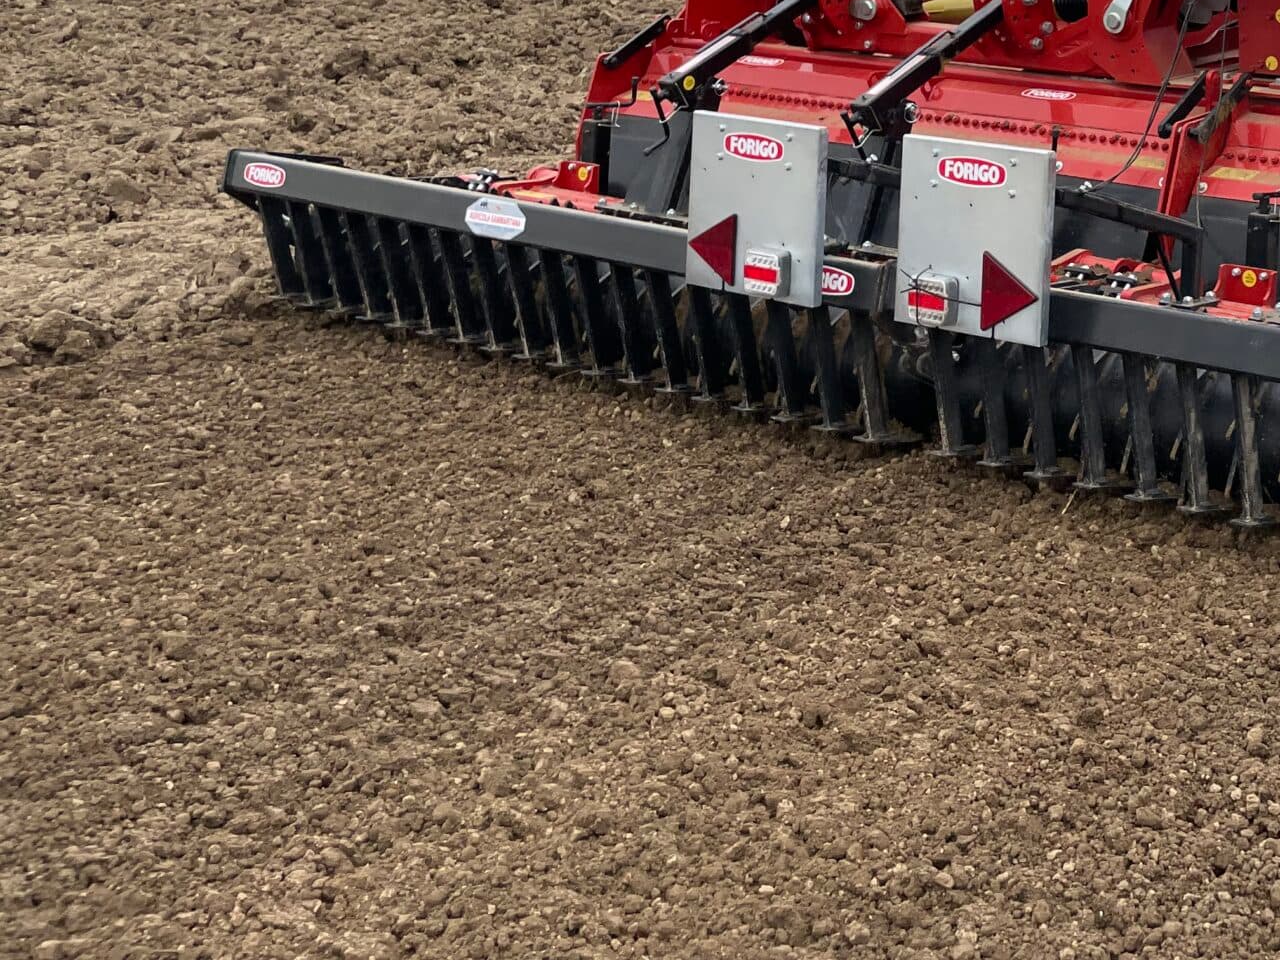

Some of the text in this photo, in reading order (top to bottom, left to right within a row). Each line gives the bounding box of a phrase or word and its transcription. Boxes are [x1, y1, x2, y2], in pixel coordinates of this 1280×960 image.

[730, 136, 778, 158] FORIGO
[249, 166, 281, 185] FORIGO
[944, 160, 1000, 184] FORIGO
